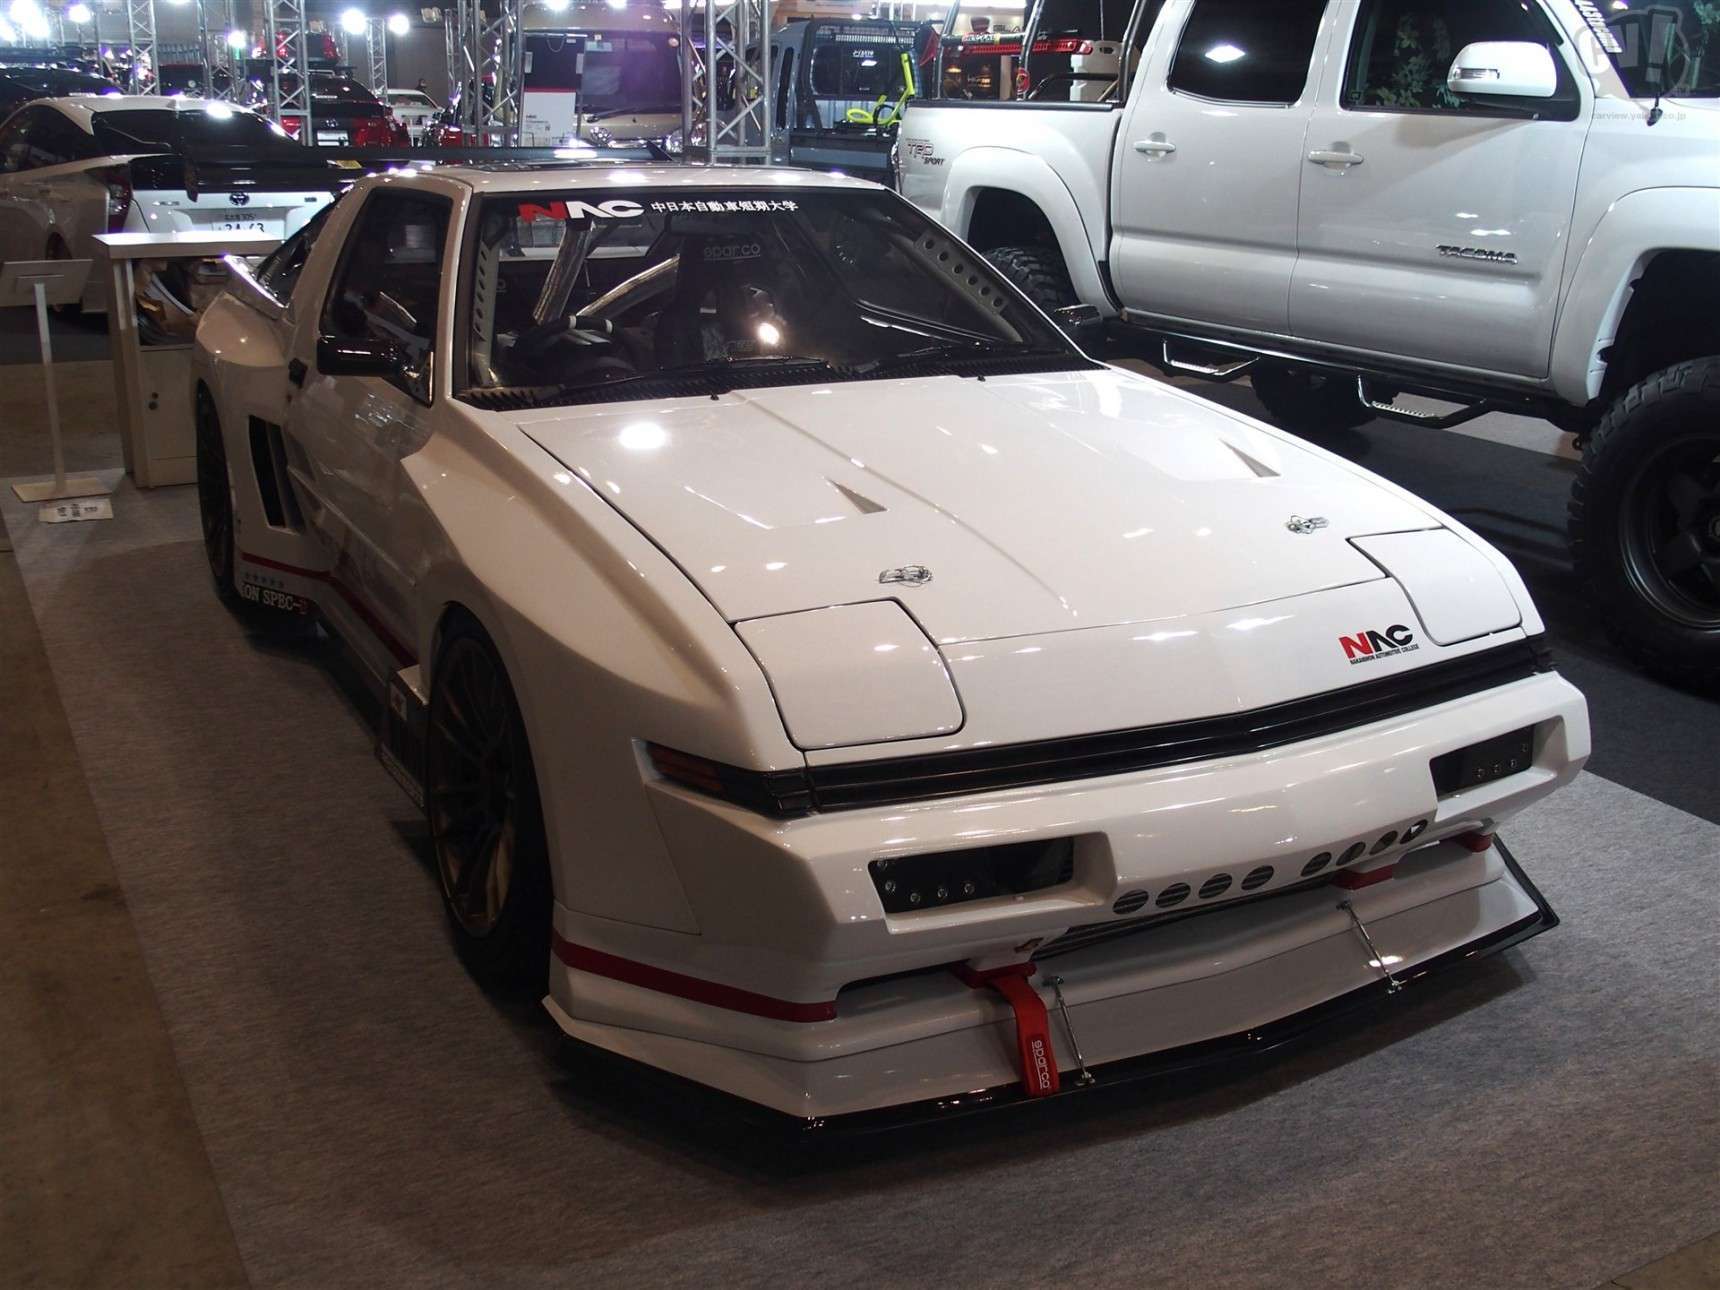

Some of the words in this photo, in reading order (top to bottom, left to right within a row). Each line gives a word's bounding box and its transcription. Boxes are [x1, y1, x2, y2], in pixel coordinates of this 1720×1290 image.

[518, 200, 645, 223] NAC
[651, 201, 799, 213] 中日本自動車短期大学
[704, 243, 761, 258] sparco
[1436, 245, 1518, 264] TACOMA
[1338, 624, 1413, 658] NAC
[1033, 1040, 1050, 1089] sparco
